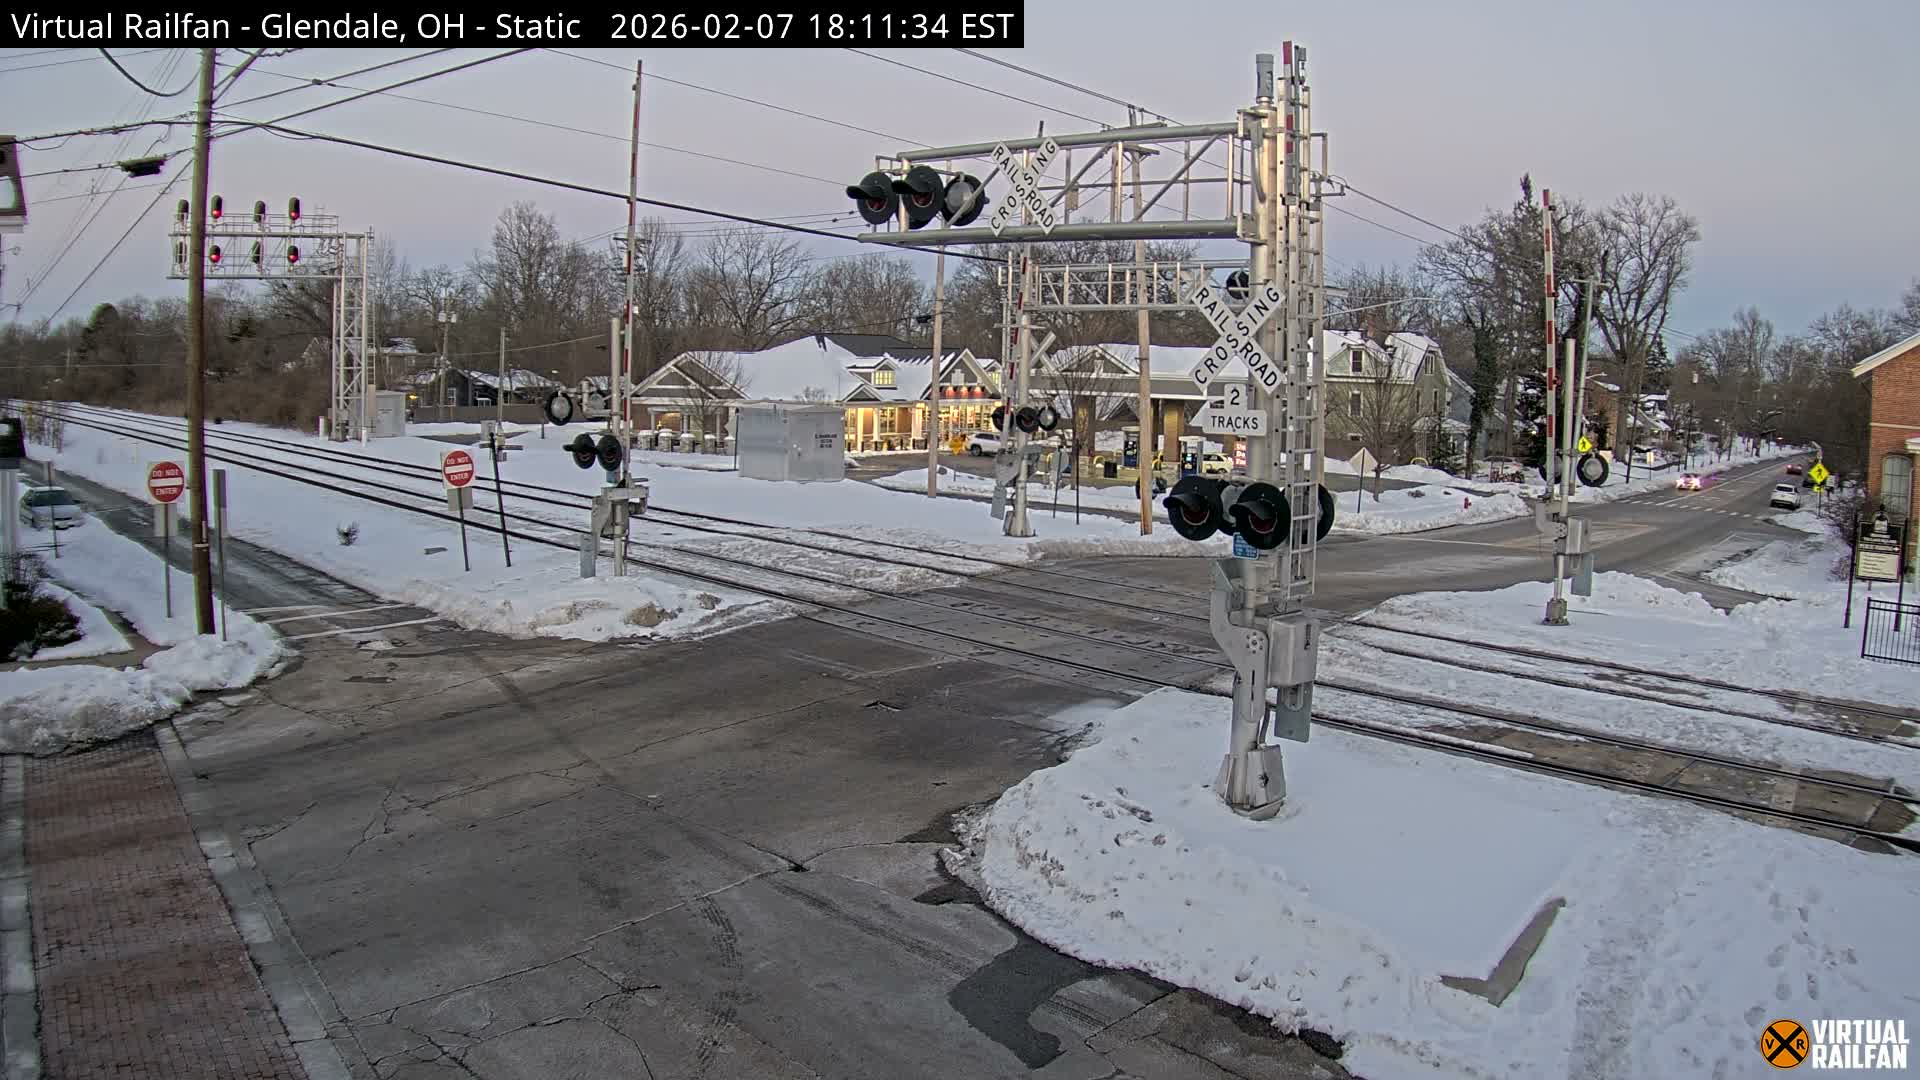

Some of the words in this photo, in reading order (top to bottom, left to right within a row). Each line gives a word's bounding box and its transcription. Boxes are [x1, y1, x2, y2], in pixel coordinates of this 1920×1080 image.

[991, 141, 1055, 230] CROSSING
[1194, 287, 1280, 385] CROSSING
[1230, 388, 1240, 406] 2
[1210, 415, 1259, 430] TRACKS
[446, 457, 455, 465] DO
[450, 472, 469, 480] ENTER
[155, 487, 177, 495] ENTER
